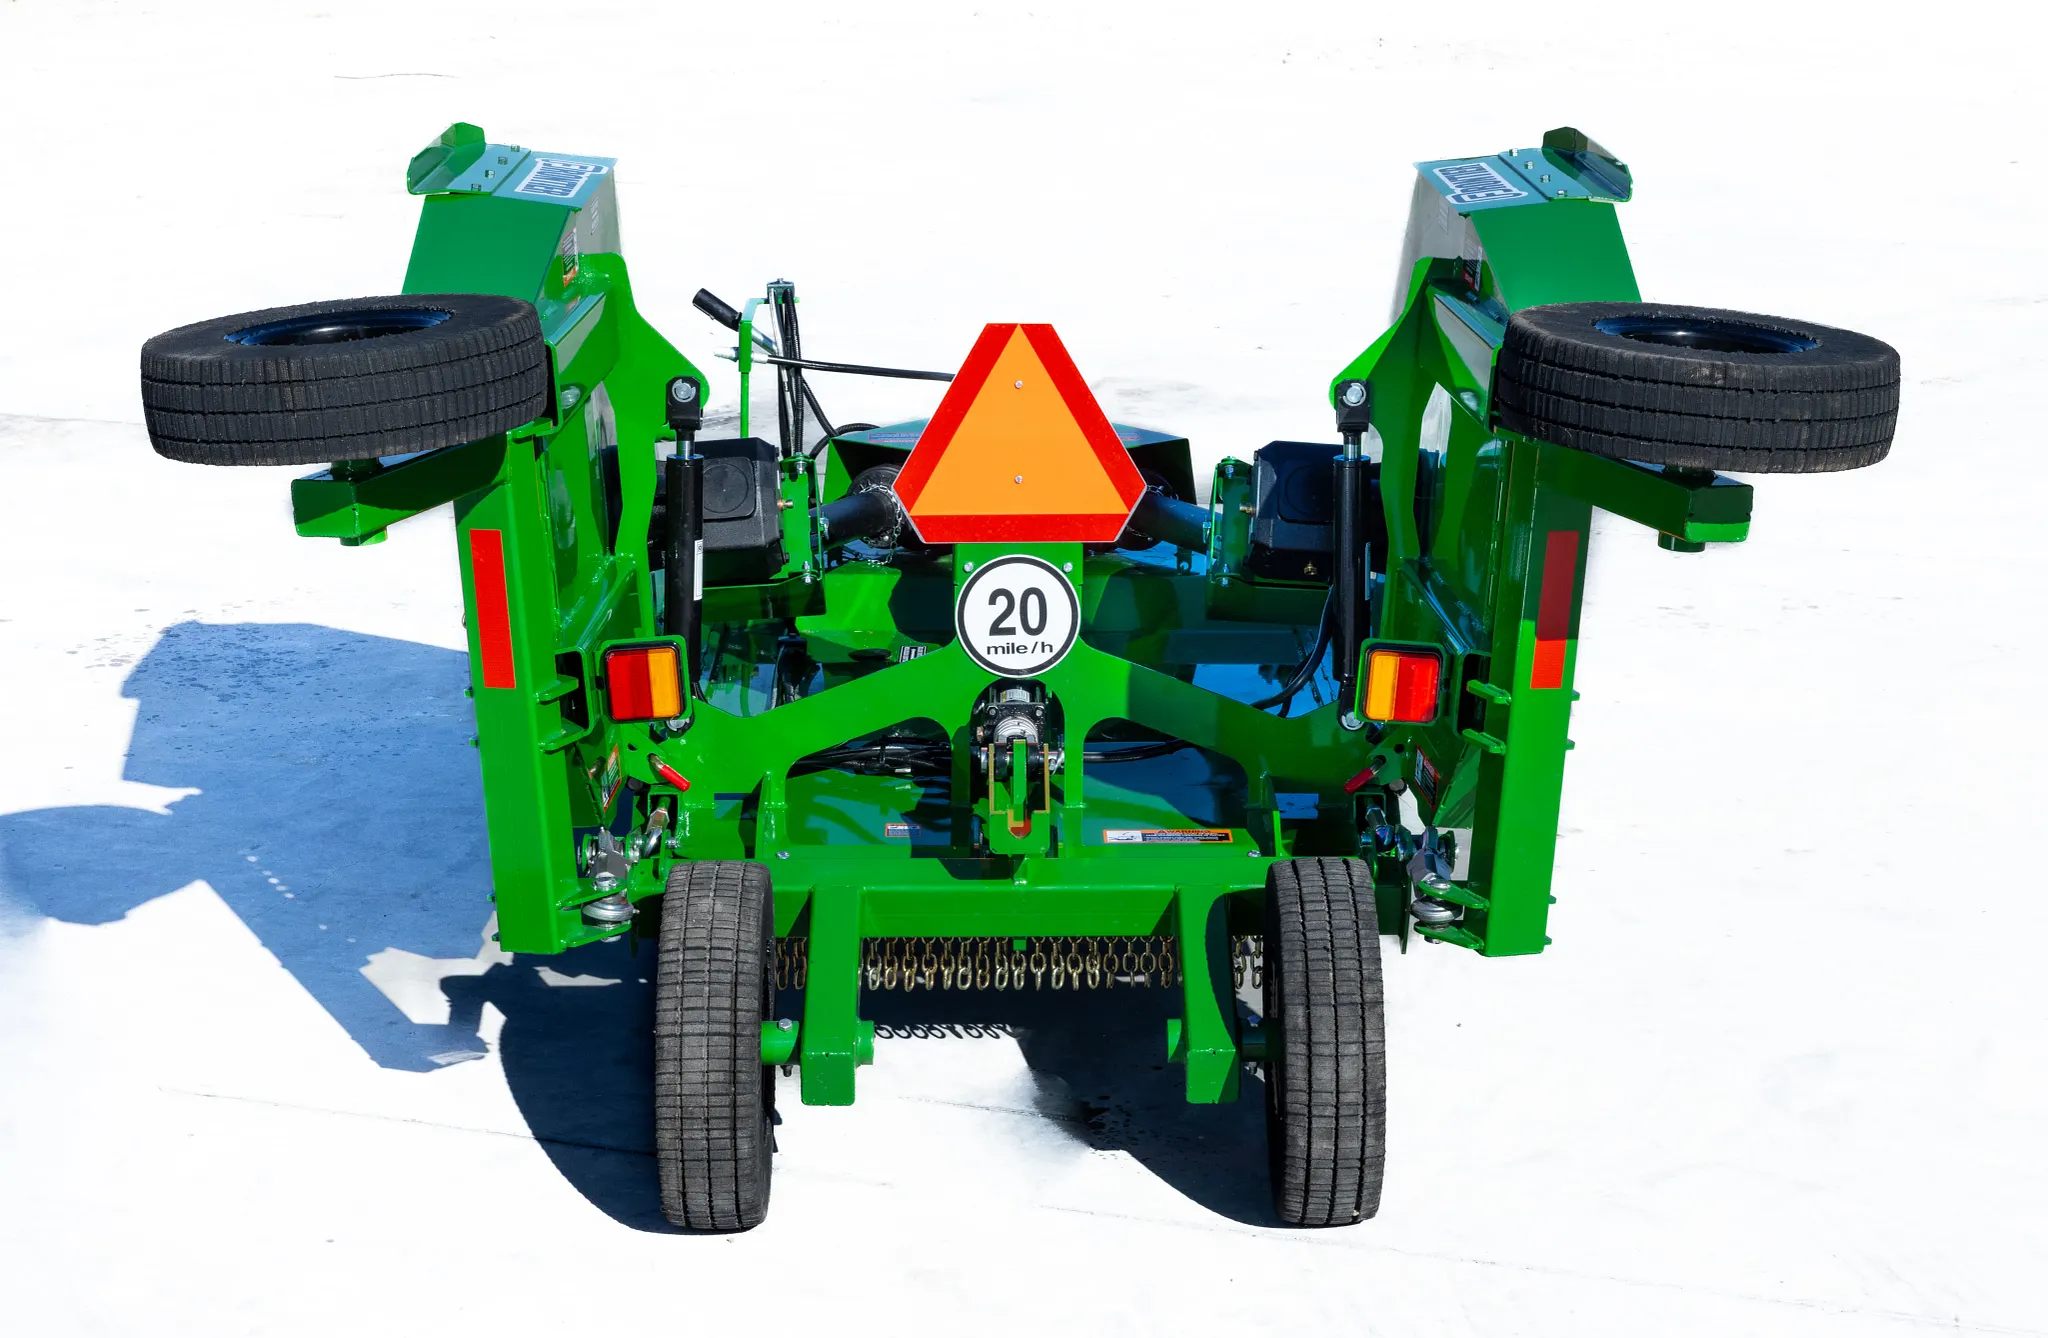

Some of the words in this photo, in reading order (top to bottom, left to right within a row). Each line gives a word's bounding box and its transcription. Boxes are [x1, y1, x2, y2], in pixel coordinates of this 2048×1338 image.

[519, 158, 604, 197] FRONTIER
[1438, 163, 1524, 203] FRONTIER
[988, 587, 1047, 636] 20
